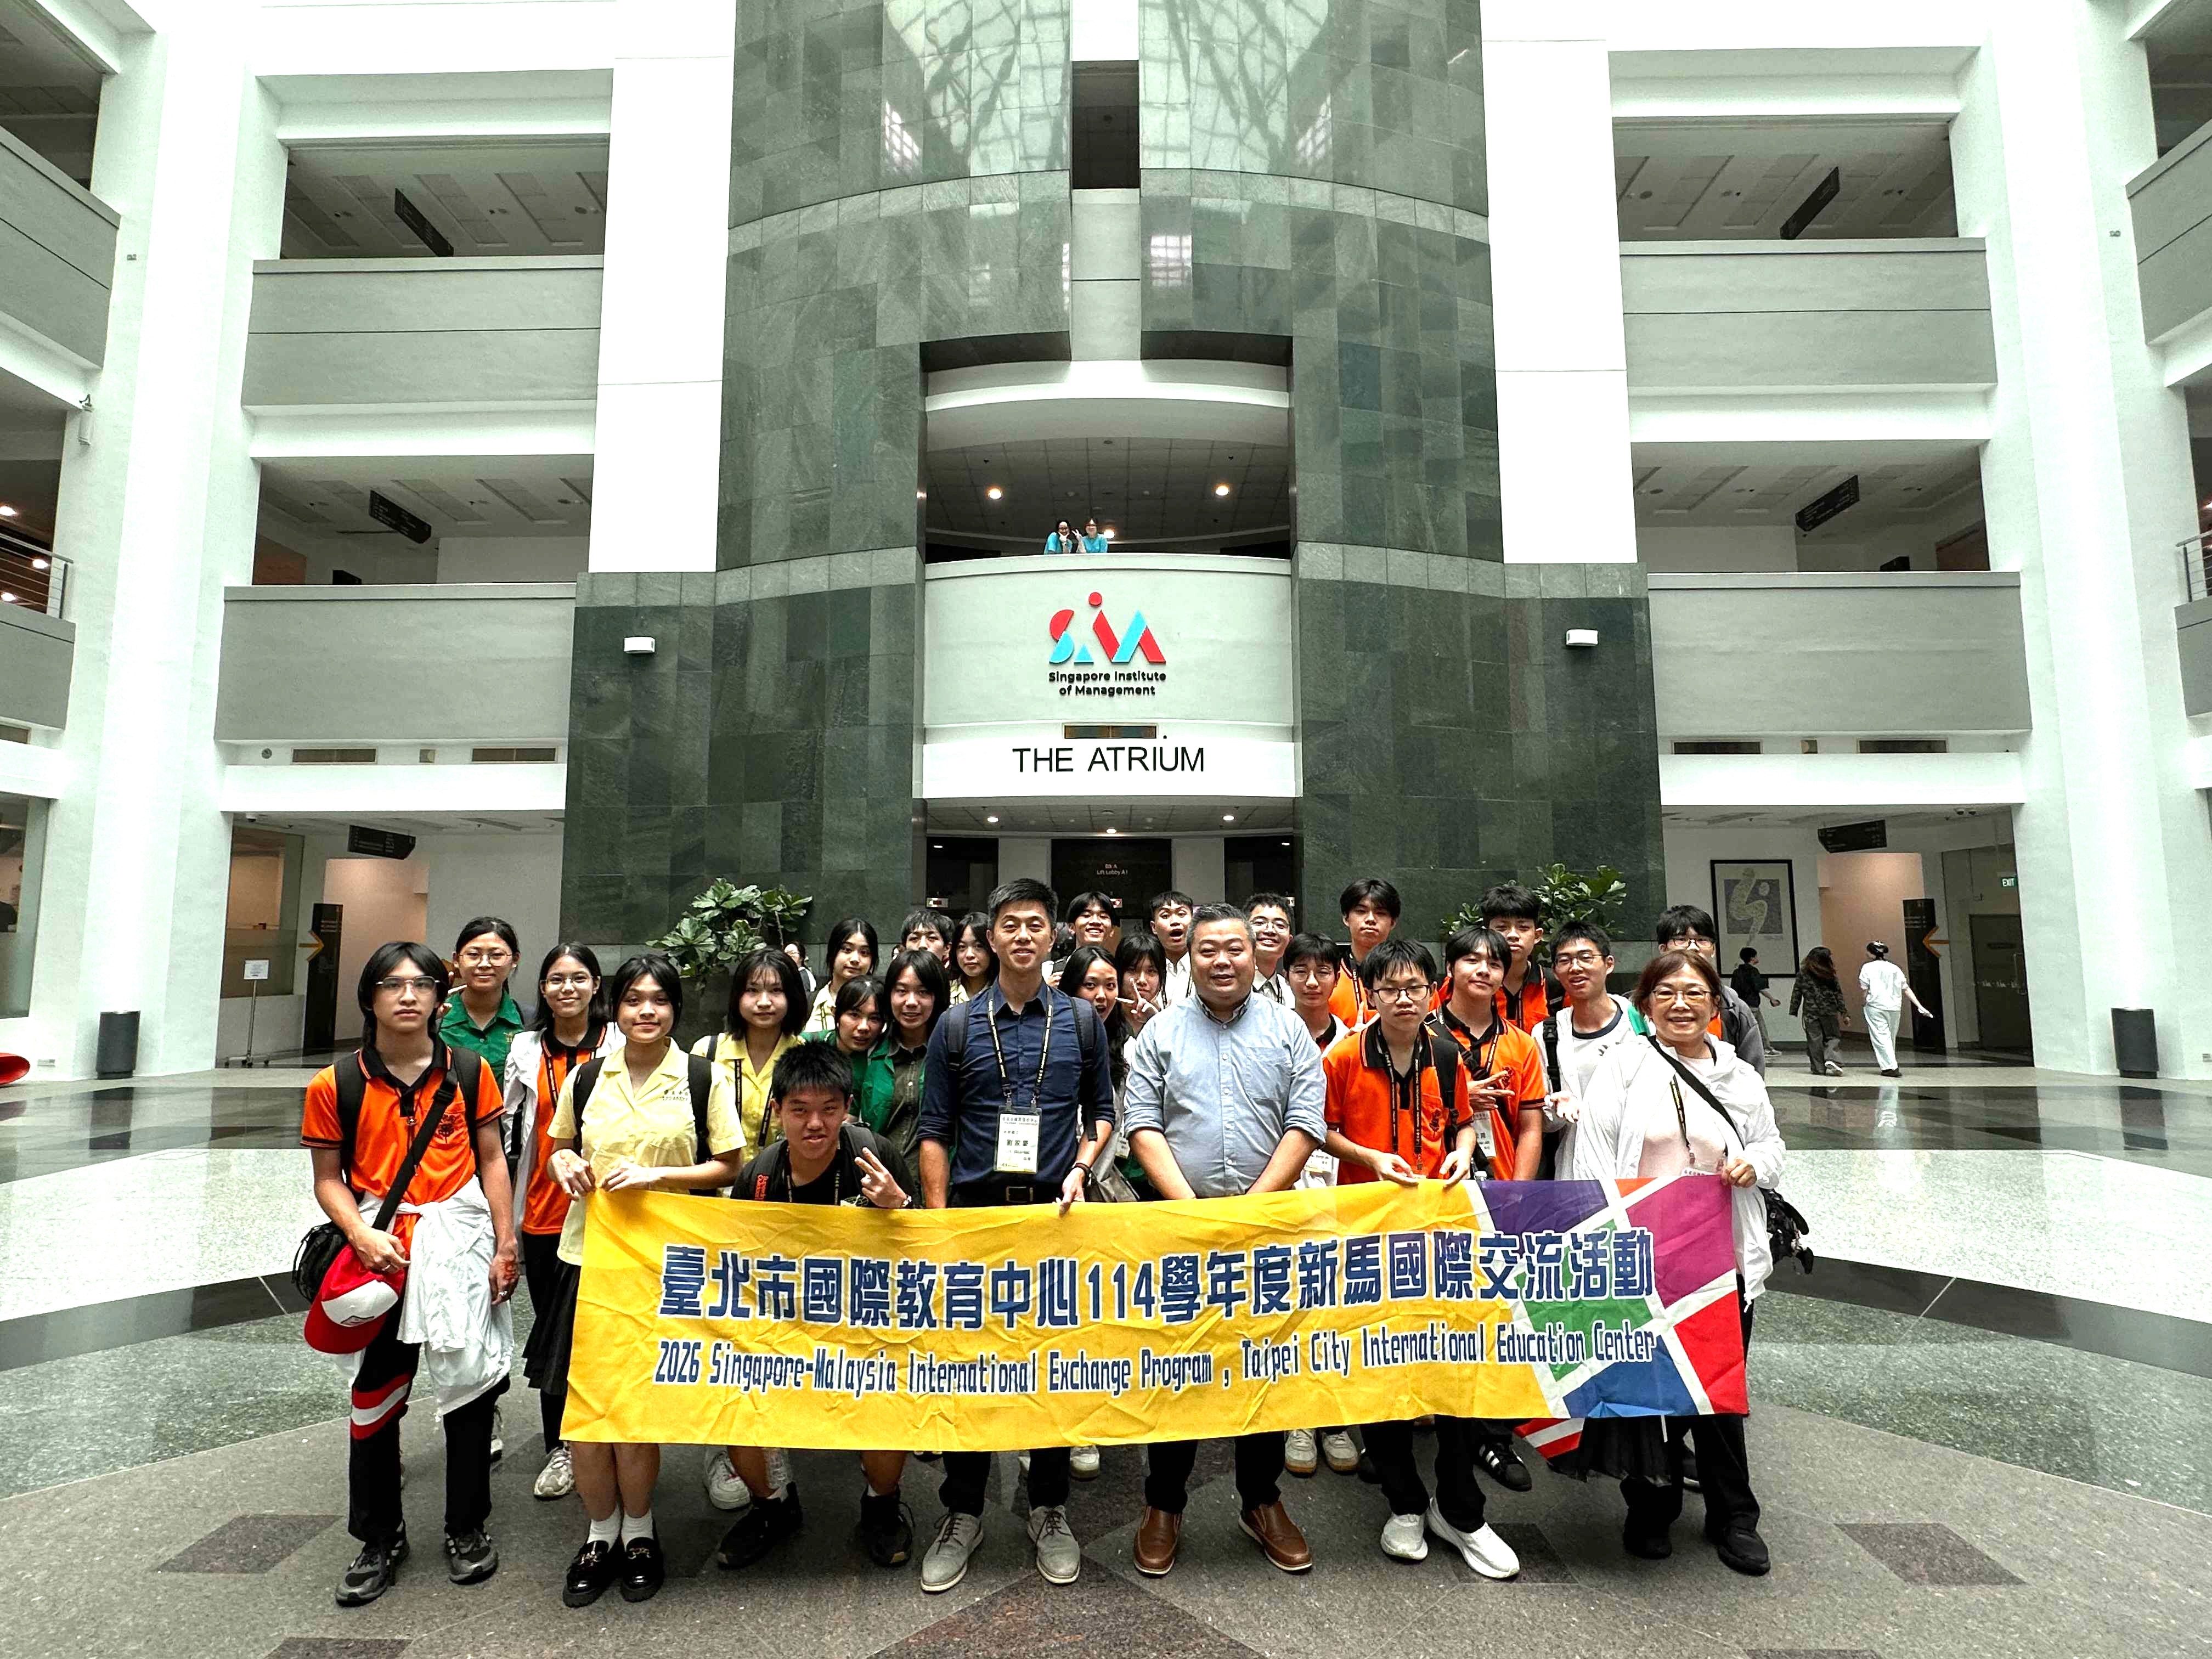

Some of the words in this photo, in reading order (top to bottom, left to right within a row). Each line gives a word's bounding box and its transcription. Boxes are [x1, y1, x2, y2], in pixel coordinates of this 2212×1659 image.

[1048, 671, 1110, 683] Singapore
[1114, 670, 1166, 681] Institute
[1059, 685, 1072, 696] of
[1075, 685, 1155, 697] Management
[1012, 747, 1074, 772] THE
[1087, 747, 1204, 772] ATRIUM
[2002, 878, 2015, 887] EXIT
[659, 1229, 1653, 1328] 臺北市國際教育中心114學年度新馬國際交流活動
[655, 1341, 701, 1383] 2026
[709, 1342, 896, 1398] Singapore-Malaysia
[909, 1352, 1036, 1392] International
[1049, 1351, 1131, 1395] Exchange
[1141, 1349, 1212, 1391] Program
[1242, 1335, 1299, 1382] Taipei
[1311, 1331, 1350, 1376] City
[1363, 1322, 1483, 1367] International
[1497, 1323, 1585, 1363] Education
[1594, 1321, 1656, 1363] Center
